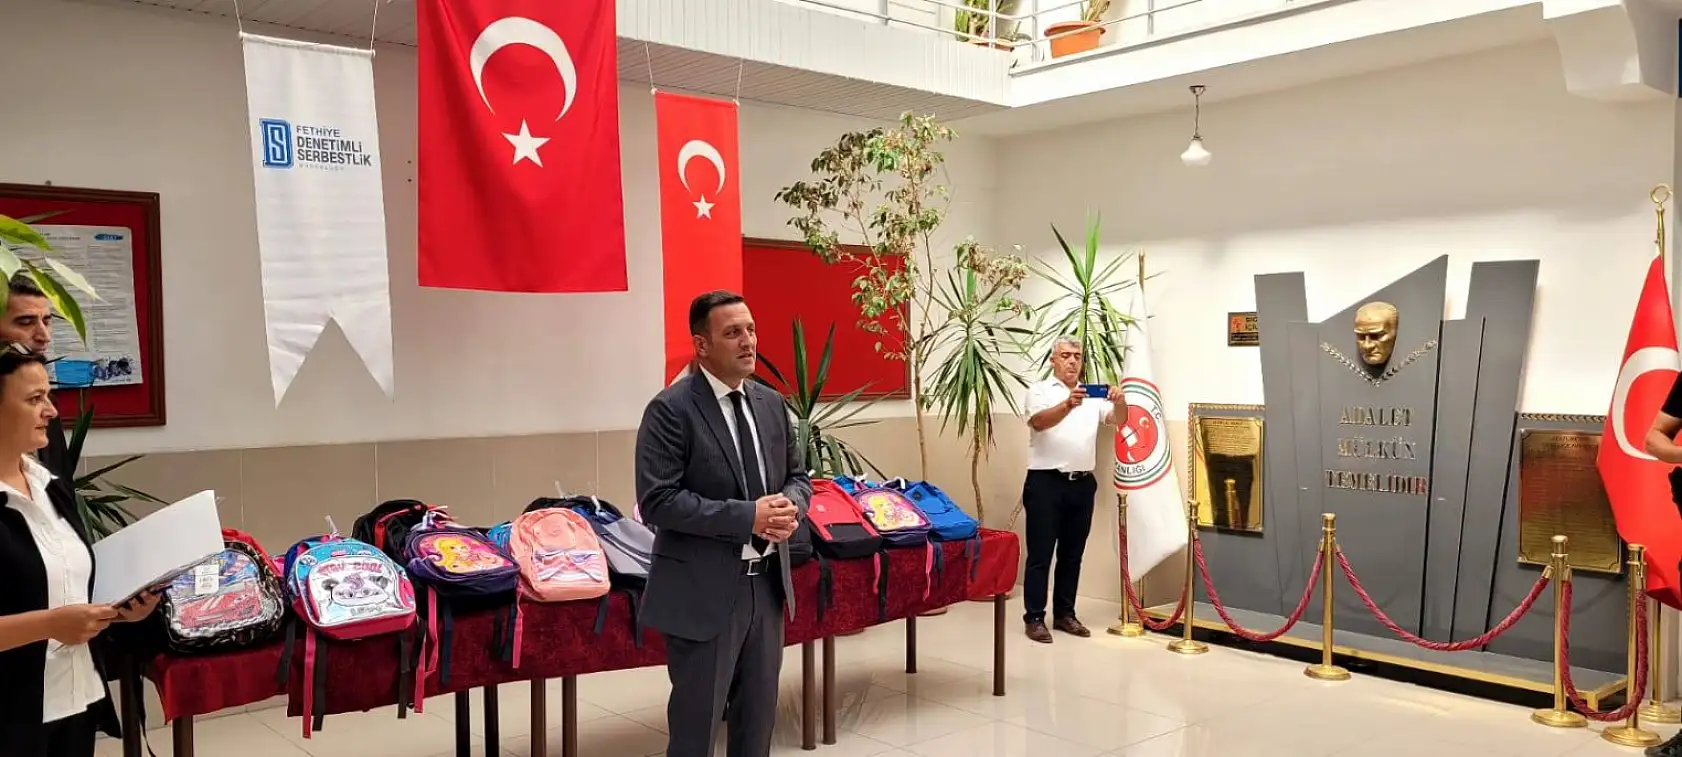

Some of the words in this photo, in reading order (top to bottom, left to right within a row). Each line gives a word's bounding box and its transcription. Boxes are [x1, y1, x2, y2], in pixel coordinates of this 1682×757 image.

[297, 136, 363, 153] DENETİMLİ
[297, 148, 373, 167] SERBESTLİK
[1339, 405, 1414, 427] ADALET
[1337, 436, 1417, 460] MÜLKÜN
